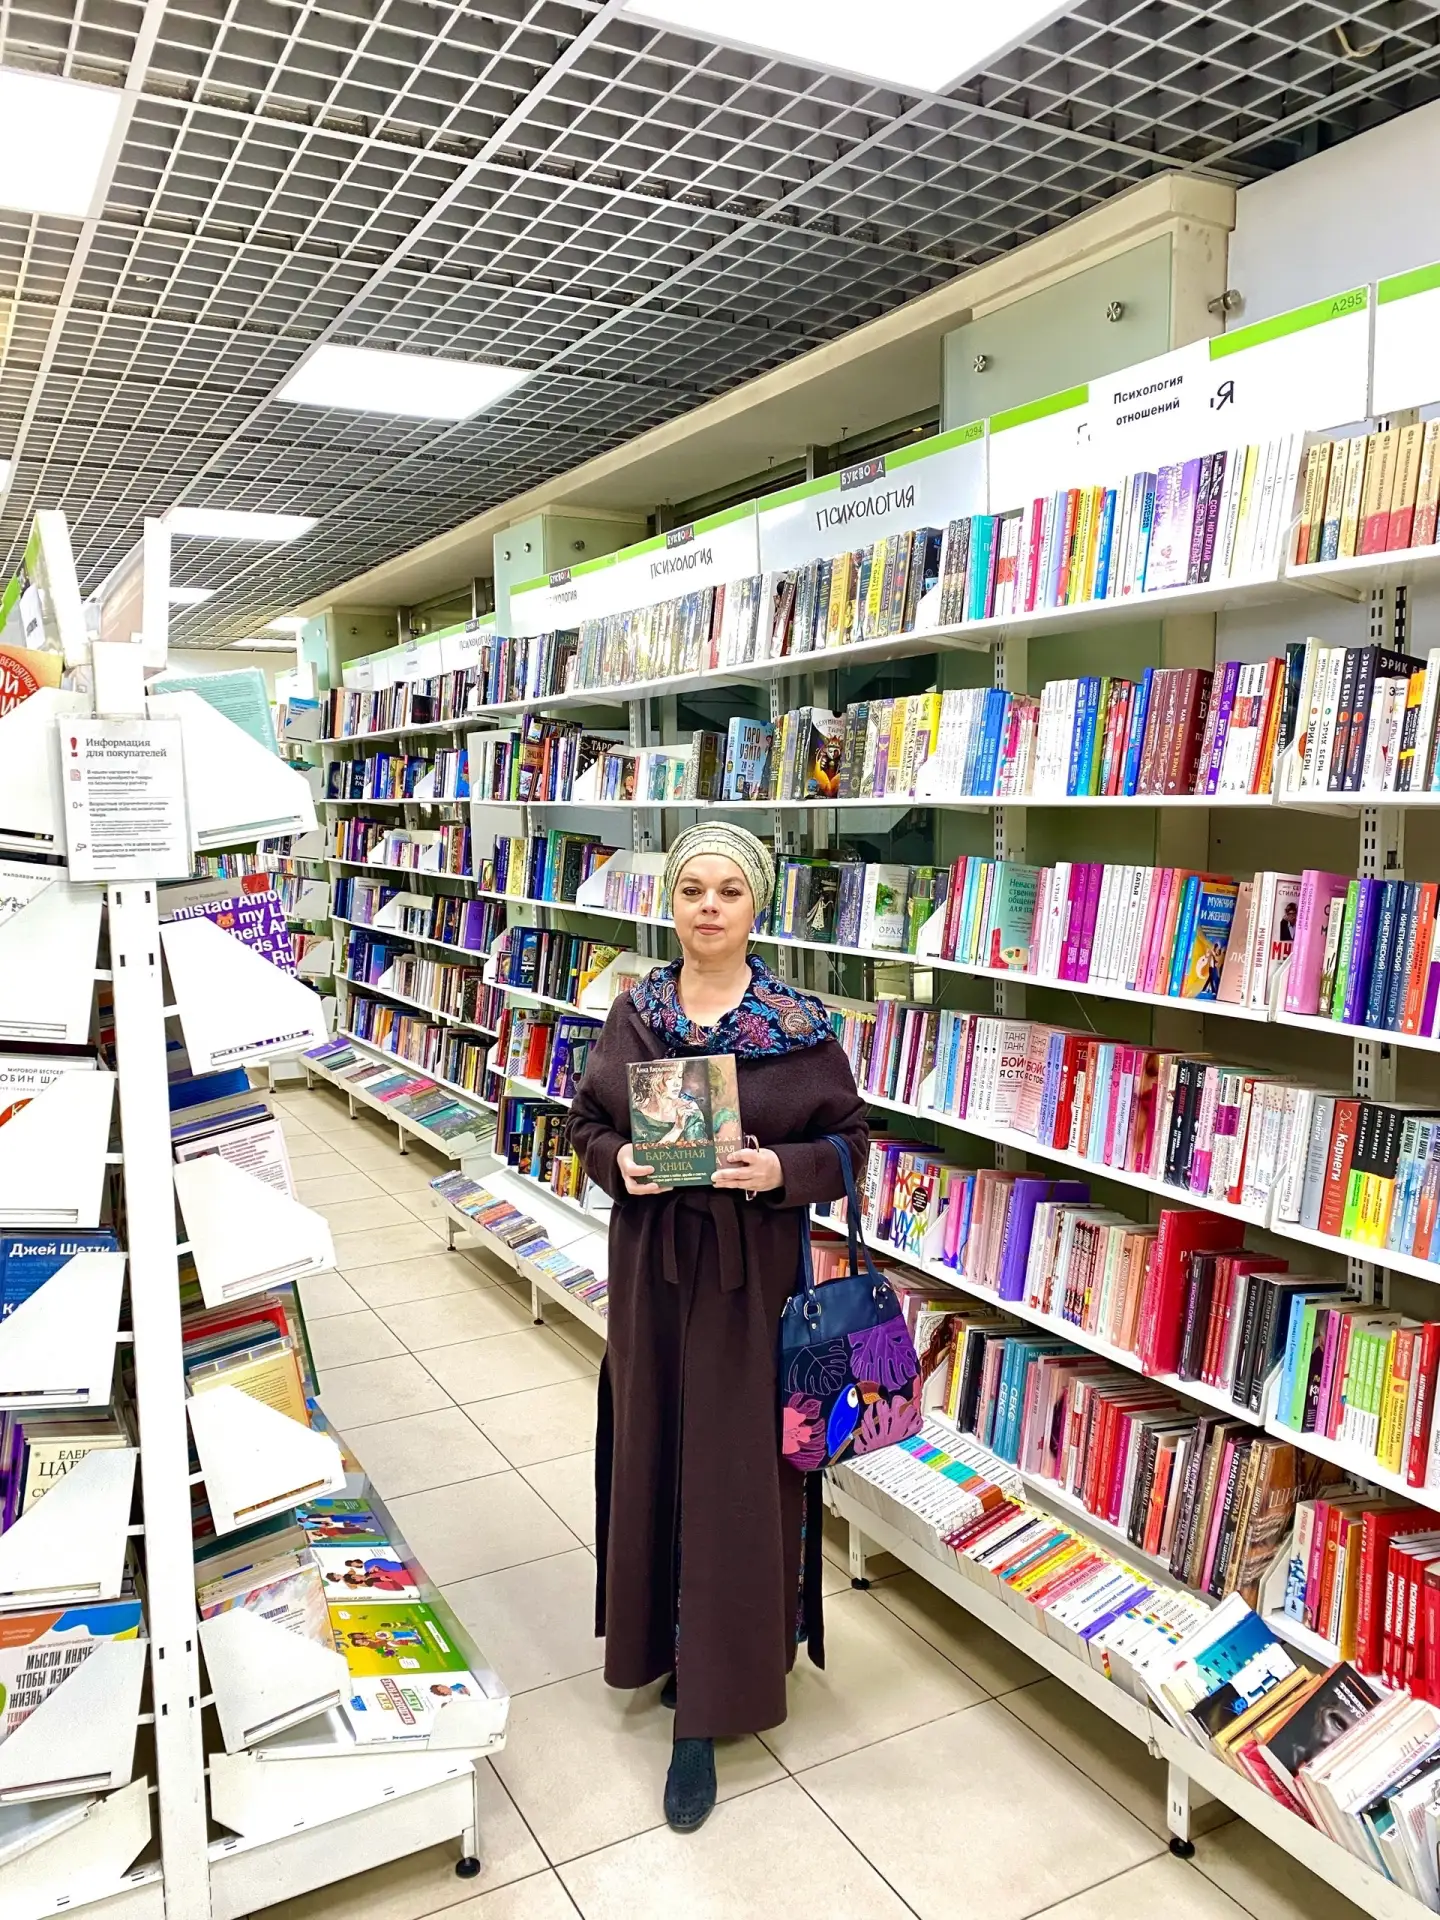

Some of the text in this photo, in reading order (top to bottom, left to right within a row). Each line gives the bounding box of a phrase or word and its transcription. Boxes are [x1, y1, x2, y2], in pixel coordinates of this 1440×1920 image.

[1113, 374, 1184, 405] Психология
[1116, 397, 1181, 427] отношений
[815, 484, 916, 532] ПСИХОЛОГИЯ
[650, 547, 713, 580] ПСИХОЛОГИЯ
[1340, 653, 1354, 707] ЭРИК БЕРН
[1355, 653, 1369, 707] ЭРИК БЕРН
[1380, 656, 1408, 674] ЭРИК
[85, 738, 150, 748] Информация
[744, 725, 761, 743] ТАРО
[1082, 716, 1092, 757] МАТЕРИНСКАЯ
[1302, 720, 1316, 770] ЭРИК БЕРН
[106, 749, 167, 758] покупателей
[1316, 749, 1326, 771] БЕРН
[1132, 871, 1141, 895] САТЬЯ
[238, 908, 266, 924] my
[1339, 921, 1352, 967] ПОМОЩЬ
[1377, 911, 1391, 969] КИНЕТИЧЕСКИЙ
[1393, 913, 1407, 971] КИНЕТИЧЕСКИЙ
[1004, 1042, 1025, 1051] ТАНК
[1005, 1032, 1026, 1041] ТАНЯ
[1001, 1055, 1027, 1068] БОЙ
[1313, 1104, 1325, 1140] Карнеги
[645, 1149, 706, 1161] БАРХАТНАЯ
[1357, 1126, 1366, 1156] КАРНЕГИ
[1371, 1129, 1380, 1159] КАРНЕГИ
[1383, 1132, 1392, 1162] КАРНЕГИ
[1403, 1133, 1414, 1153] КАРНЕГИ
[1417, 1139, 1428, 1160] КАРНЕГИ
[660, 1161, 693, 1172] КНИГА
[1329, 1133, 1349, 1181] Карнеги
[9, 1242, 110, 1258] Джей Шетти
[1242, 1285, 1257, 1345] БИБЛИЯ СЕКСА
[1260, 1290, 1273, 1344] БИБЛИЯ СЕКСА
[1223, 1452, 1240, 1509] КАМАСУТРА
[1231, 1464, 1247, 1514] КАМАСУТРА
[1182, 1514, 1198, 1577] ОТТЕНКОВ ЛЮБВИ
[1383, 1571, 1395, 1632] ПСИХОТРЮКИ
[1394, 1576, 1406, 1637] ПСИХОТРЮКИ
[1407, 1582, 1417, 1644] ПСИХОТРЮКИ
[25, 1646, 94, 1671] МЫСЛИ ИНАЧЕ
[16, 1670, 47, 1690] ЧТОБЫ
[9, 1689, 42, 1710] ЖИЗНЬ
